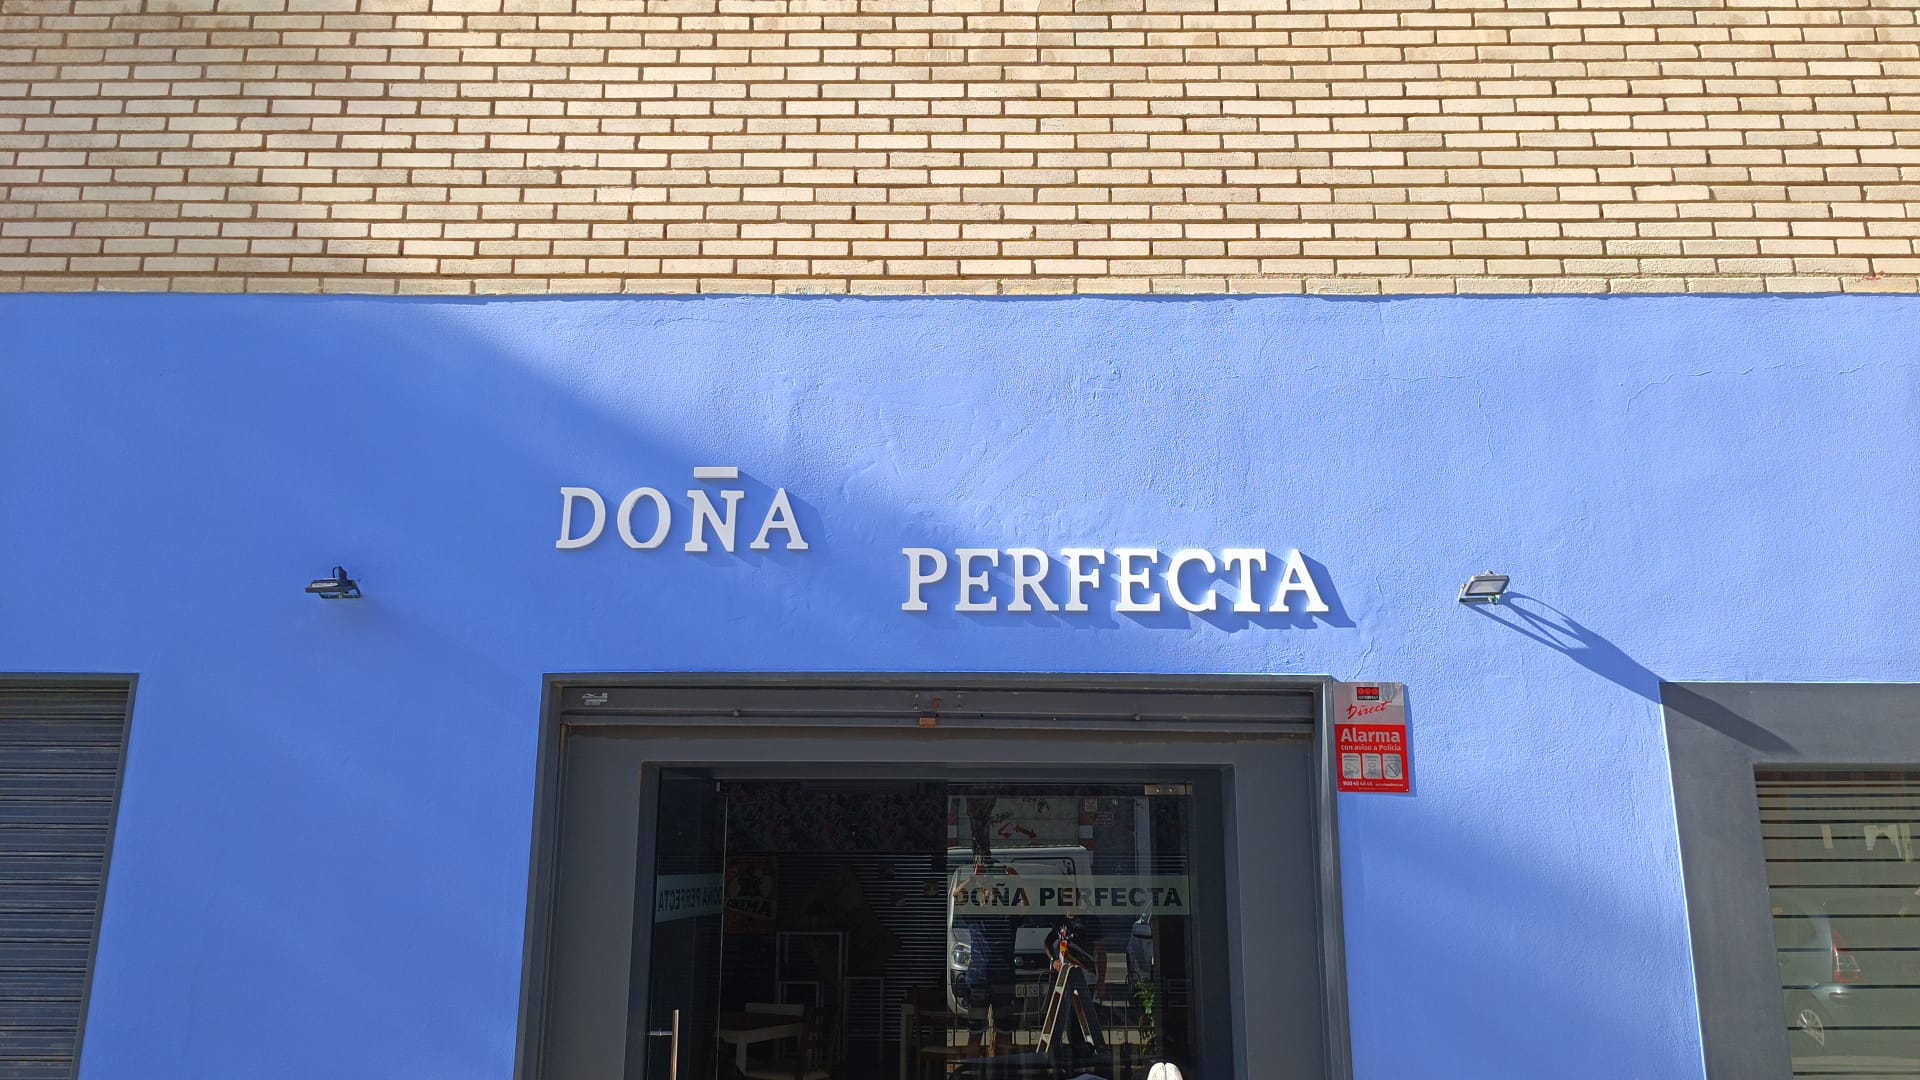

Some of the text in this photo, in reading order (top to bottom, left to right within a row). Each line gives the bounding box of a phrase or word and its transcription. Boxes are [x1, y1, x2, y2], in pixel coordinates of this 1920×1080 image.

[556, 467, 1329, 612] DOÑA PERFECTA
[1346, 700, 1392, 719] Direct
[1341, 728, 1401, 743] Alarma
[955, 883, 1184, 907] DOÑA PERFECTA
